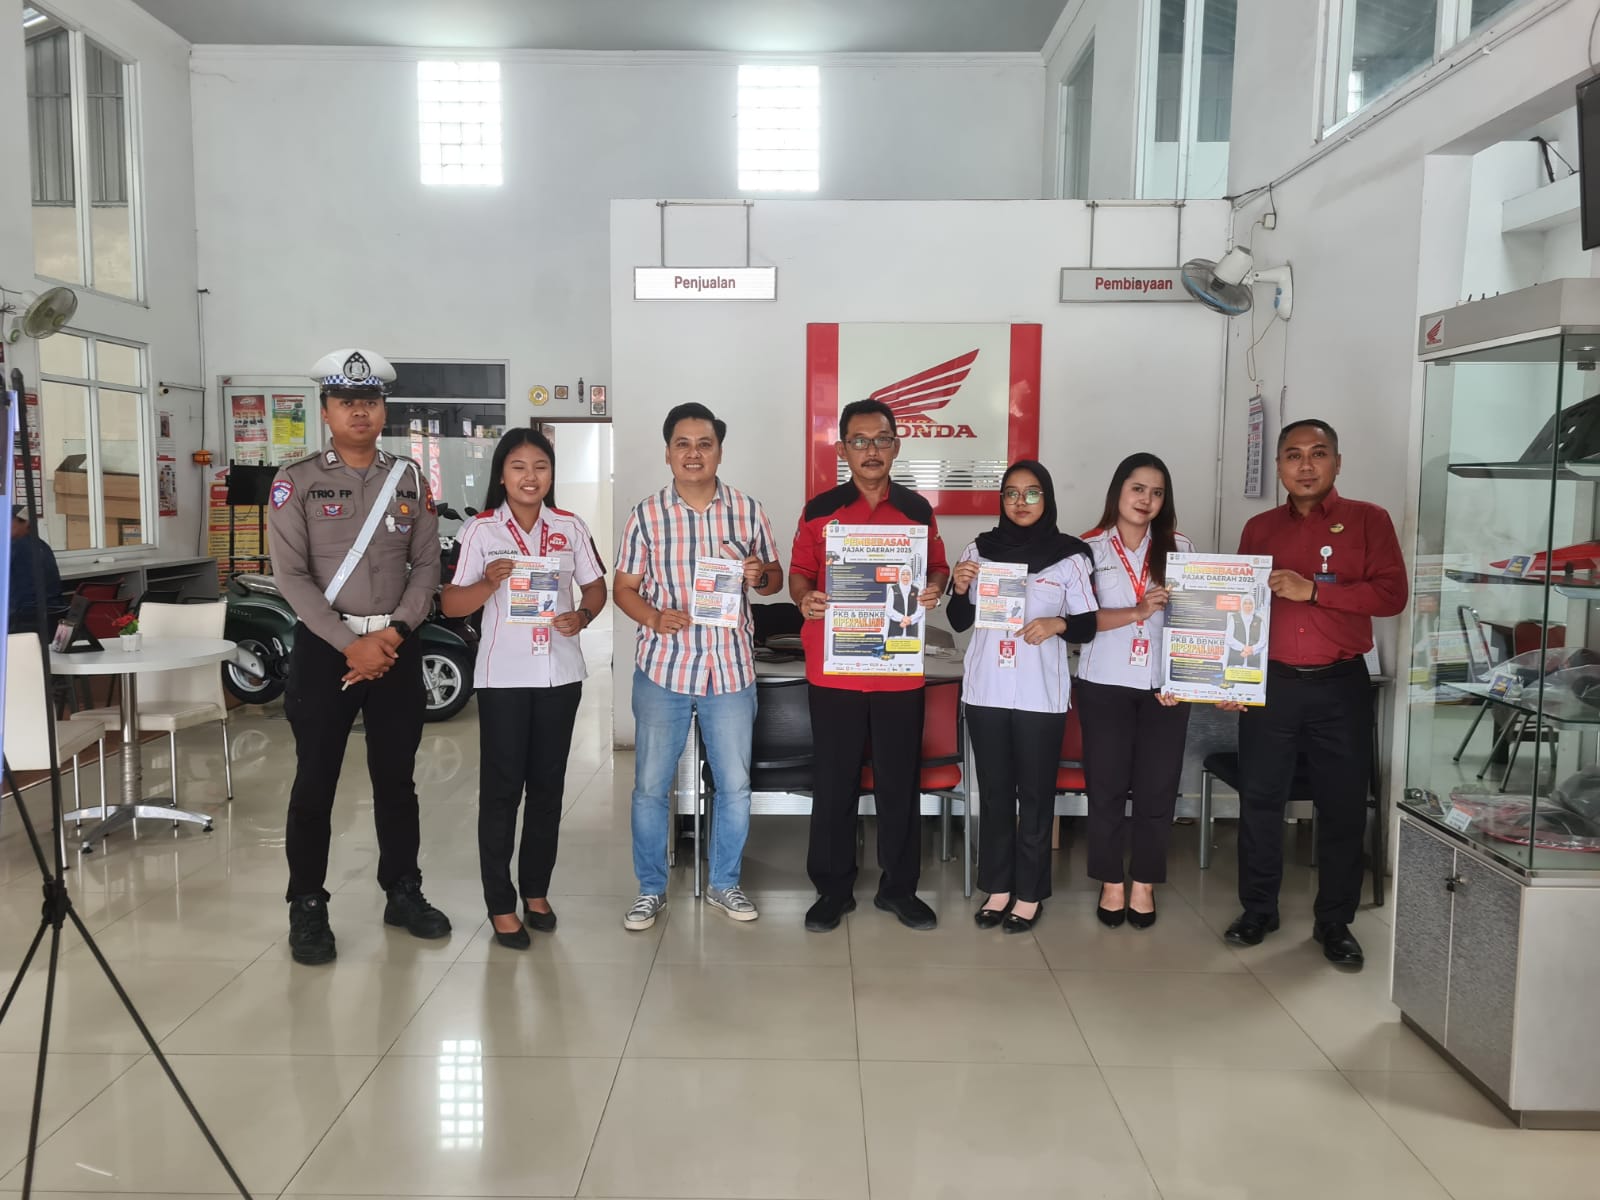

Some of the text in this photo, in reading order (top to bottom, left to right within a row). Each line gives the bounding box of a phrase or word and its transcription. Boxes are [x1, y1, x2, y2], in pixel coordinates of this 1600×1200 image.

[674, 275, 736, 292] Penjualan
[1095, 276, 1173, 293] Pembiayaan
[896, 424, 978, 438] ONDA
[310, 490, 353, 499] TRIO FP
